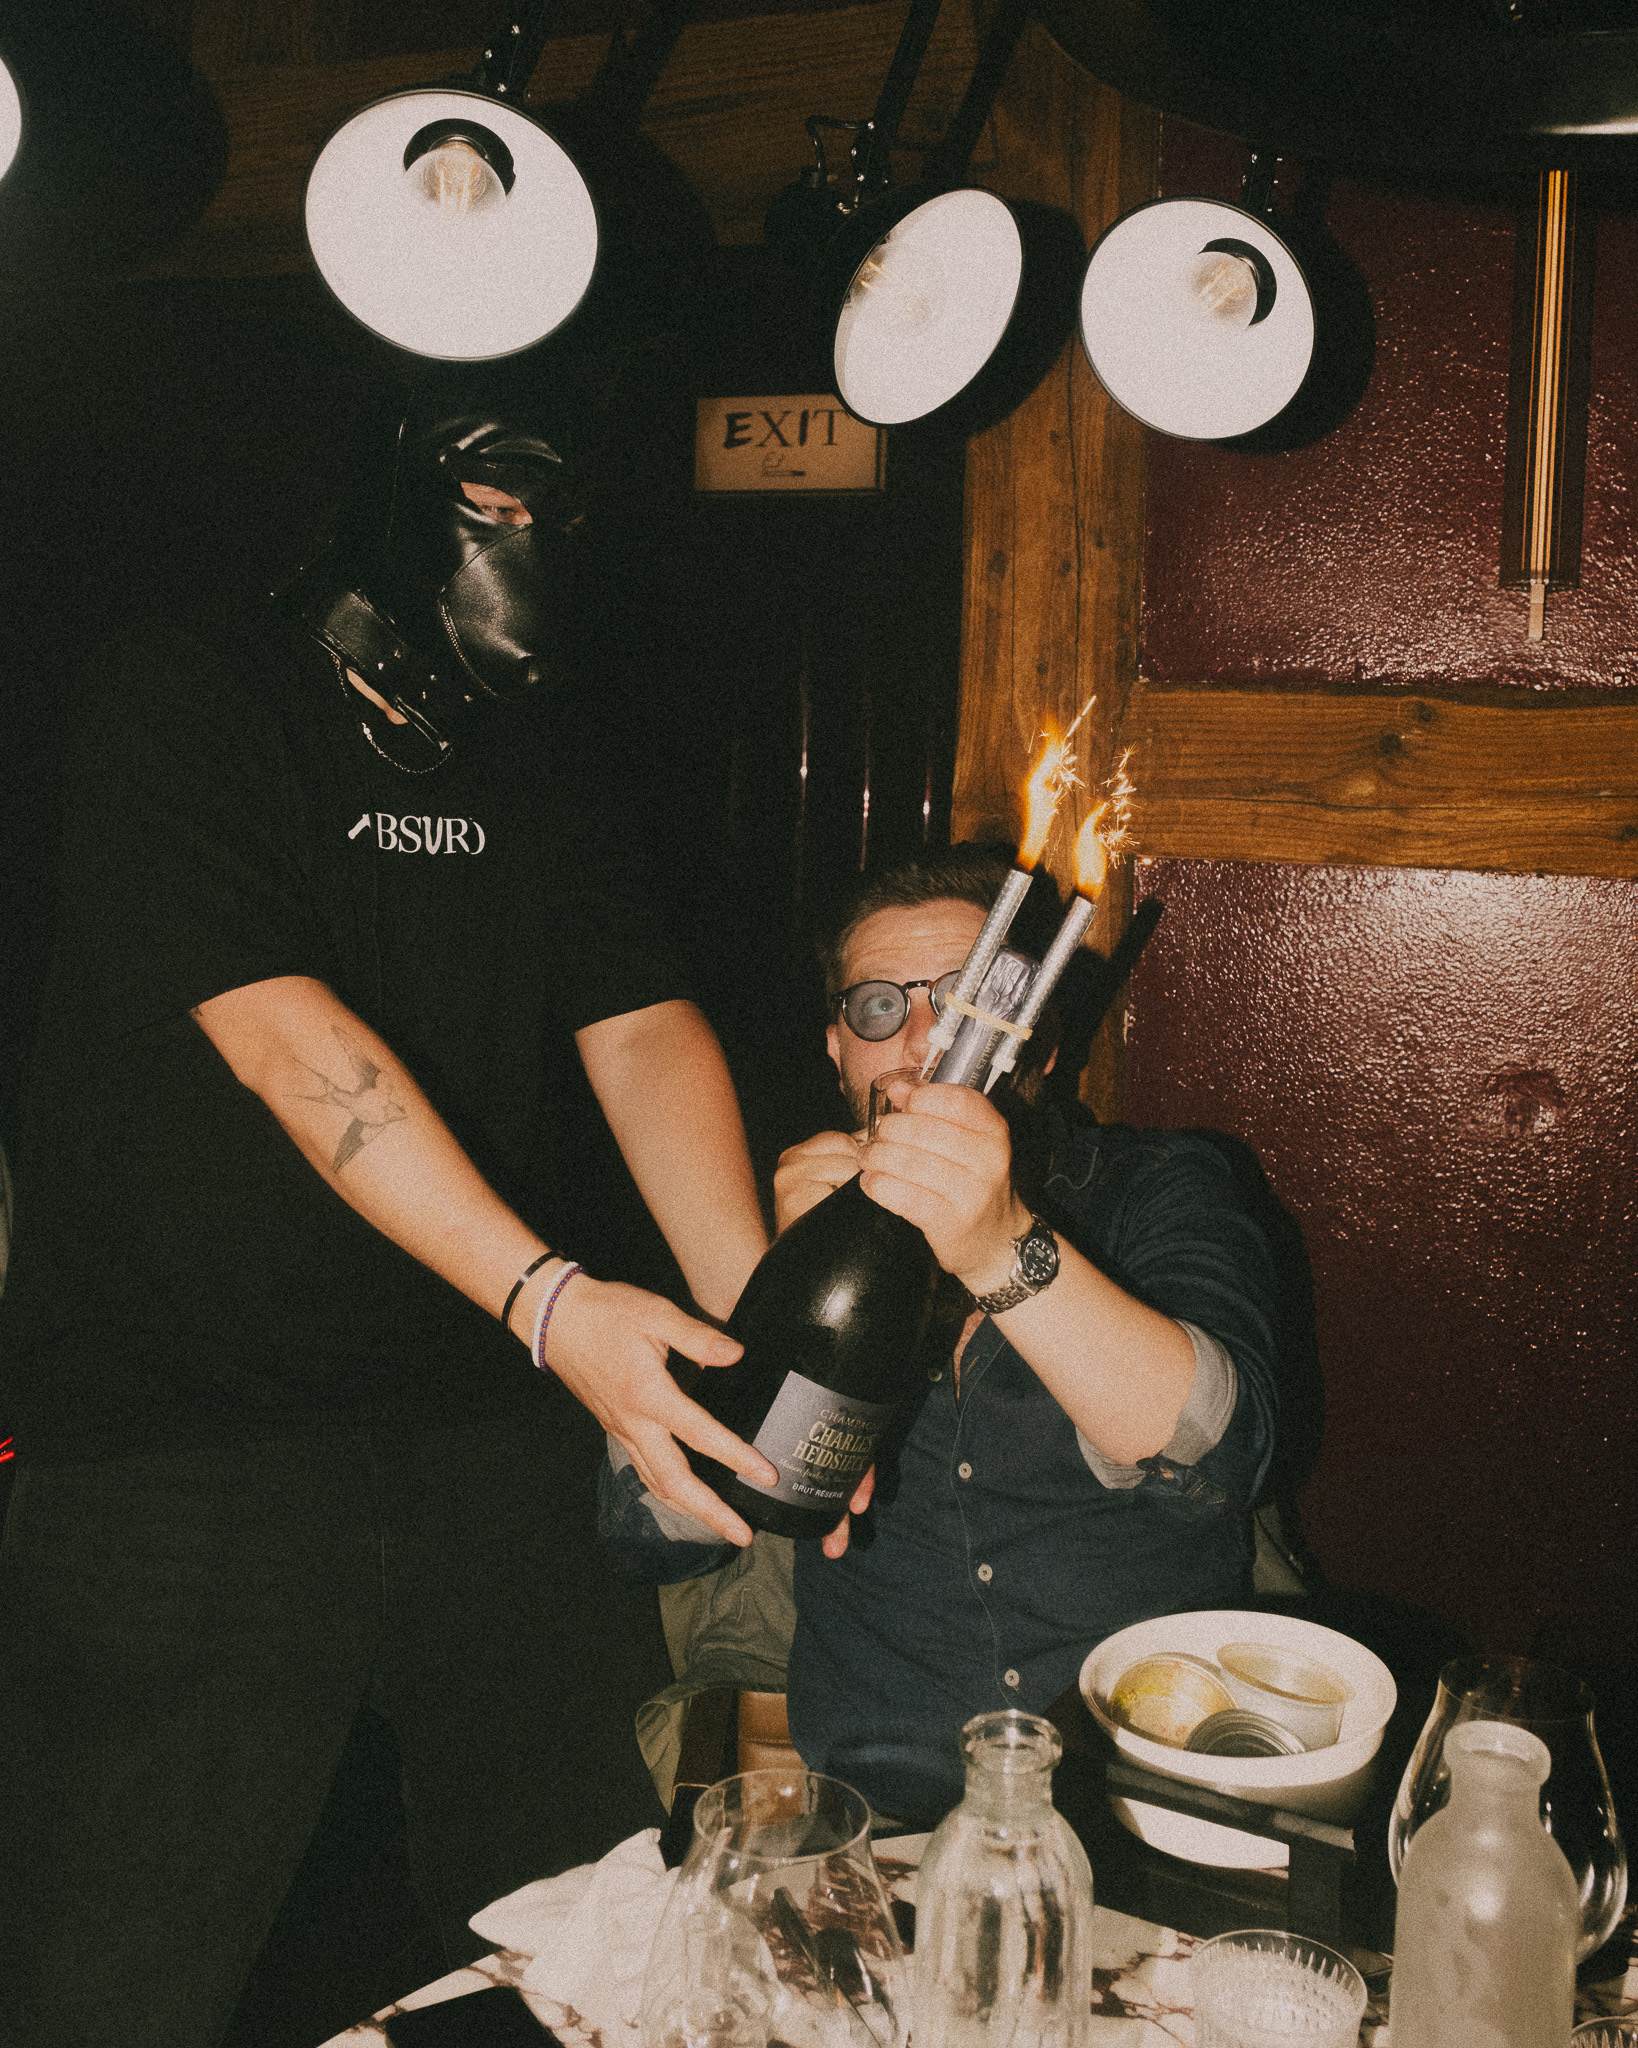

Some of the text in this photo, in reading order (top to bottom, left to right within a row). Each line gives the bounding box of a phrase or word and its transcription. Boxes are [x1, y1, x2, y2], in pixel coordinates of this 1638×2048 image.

[723, 409, 849, 449] EXIT
[820, 1409, 877, 1430] CHAMPAG
[809, 1421, 876, 1452] CHARLES
[792, 1482, 815, 1495] BRUT
